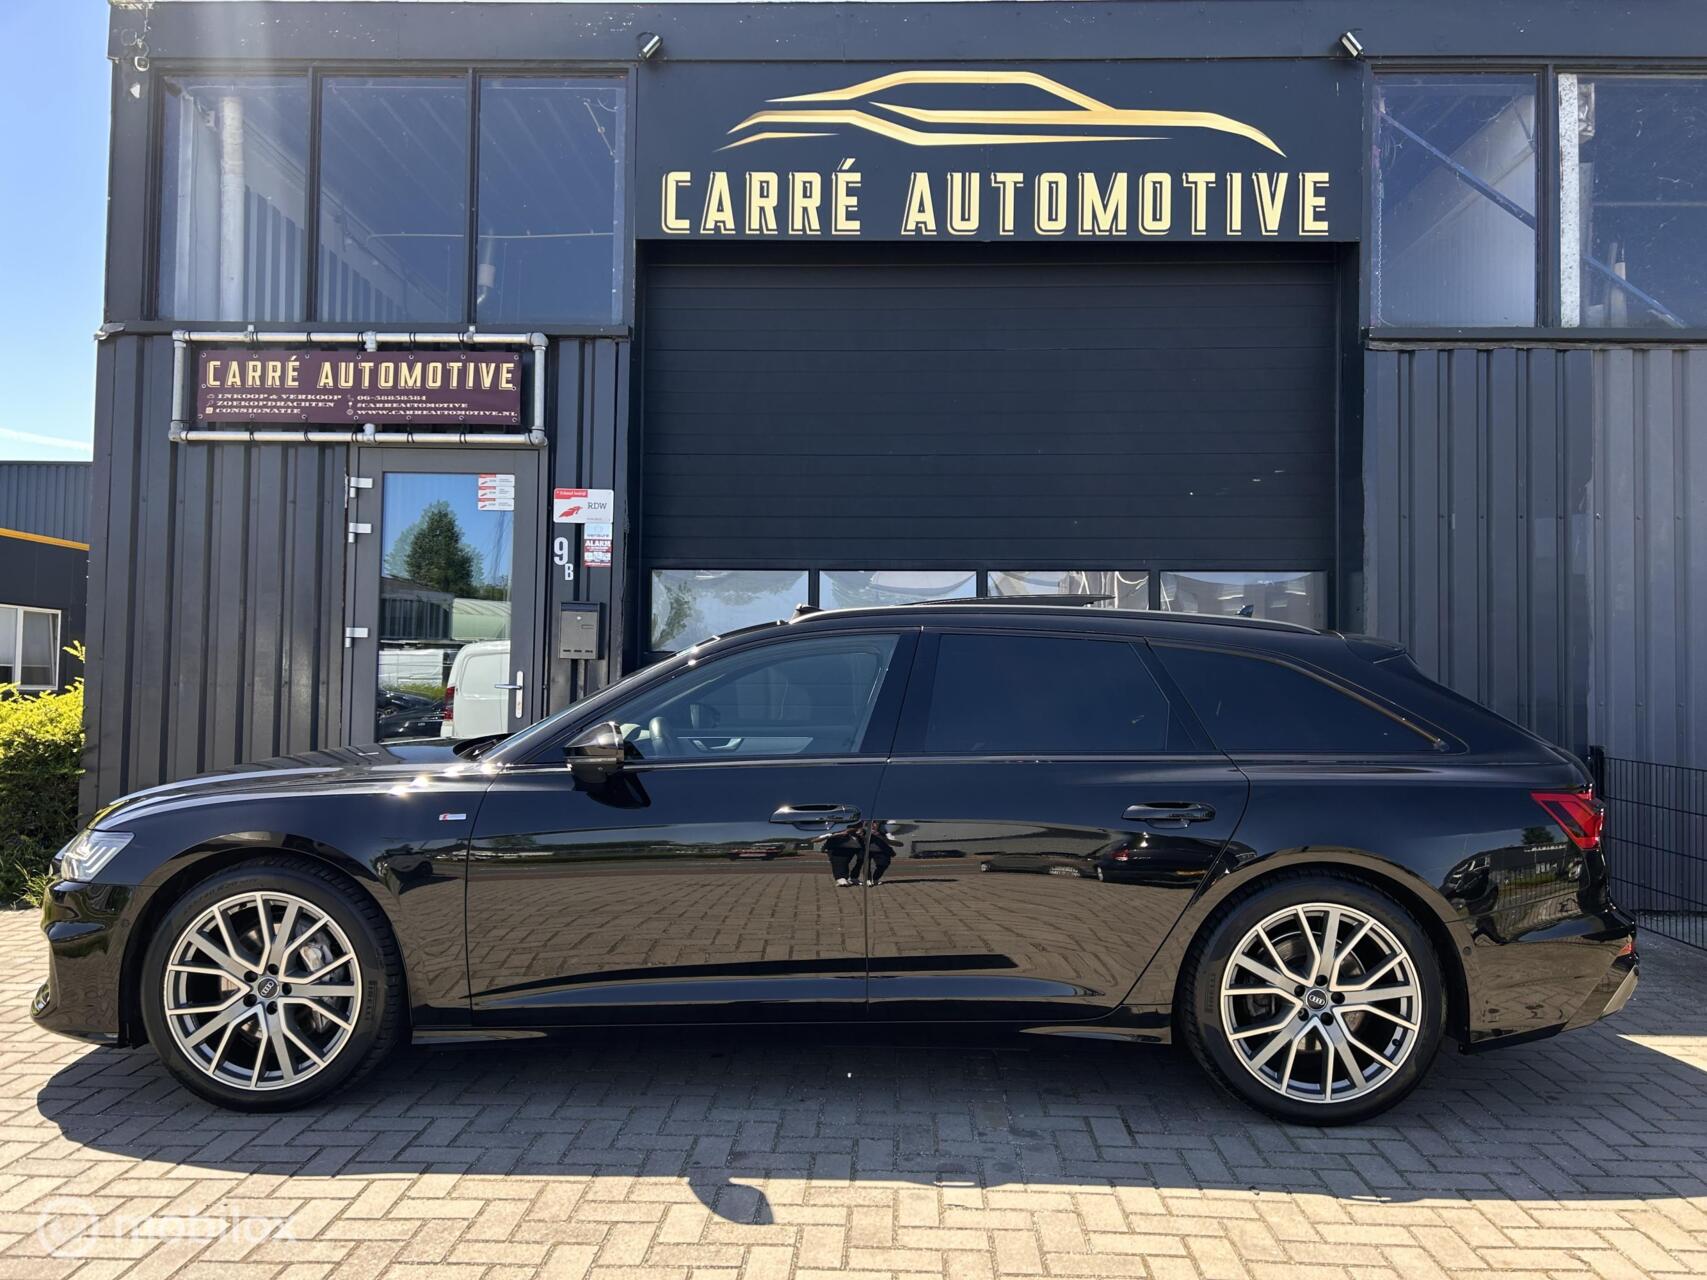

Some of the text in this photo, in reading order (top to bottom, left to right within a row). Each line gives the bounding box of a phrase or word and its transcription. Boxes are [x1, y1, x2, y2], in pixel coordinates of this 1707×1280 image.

[661, 158, 1330, 236] CARRÉ AUTOMOTIVE
[206, 356, 515, 390] CARRÉ AUTOMOTIVE
[587, 502, 608, 510] RDW
[553, 537, 569, 566] 9
[565, 563, 573, 580] B
